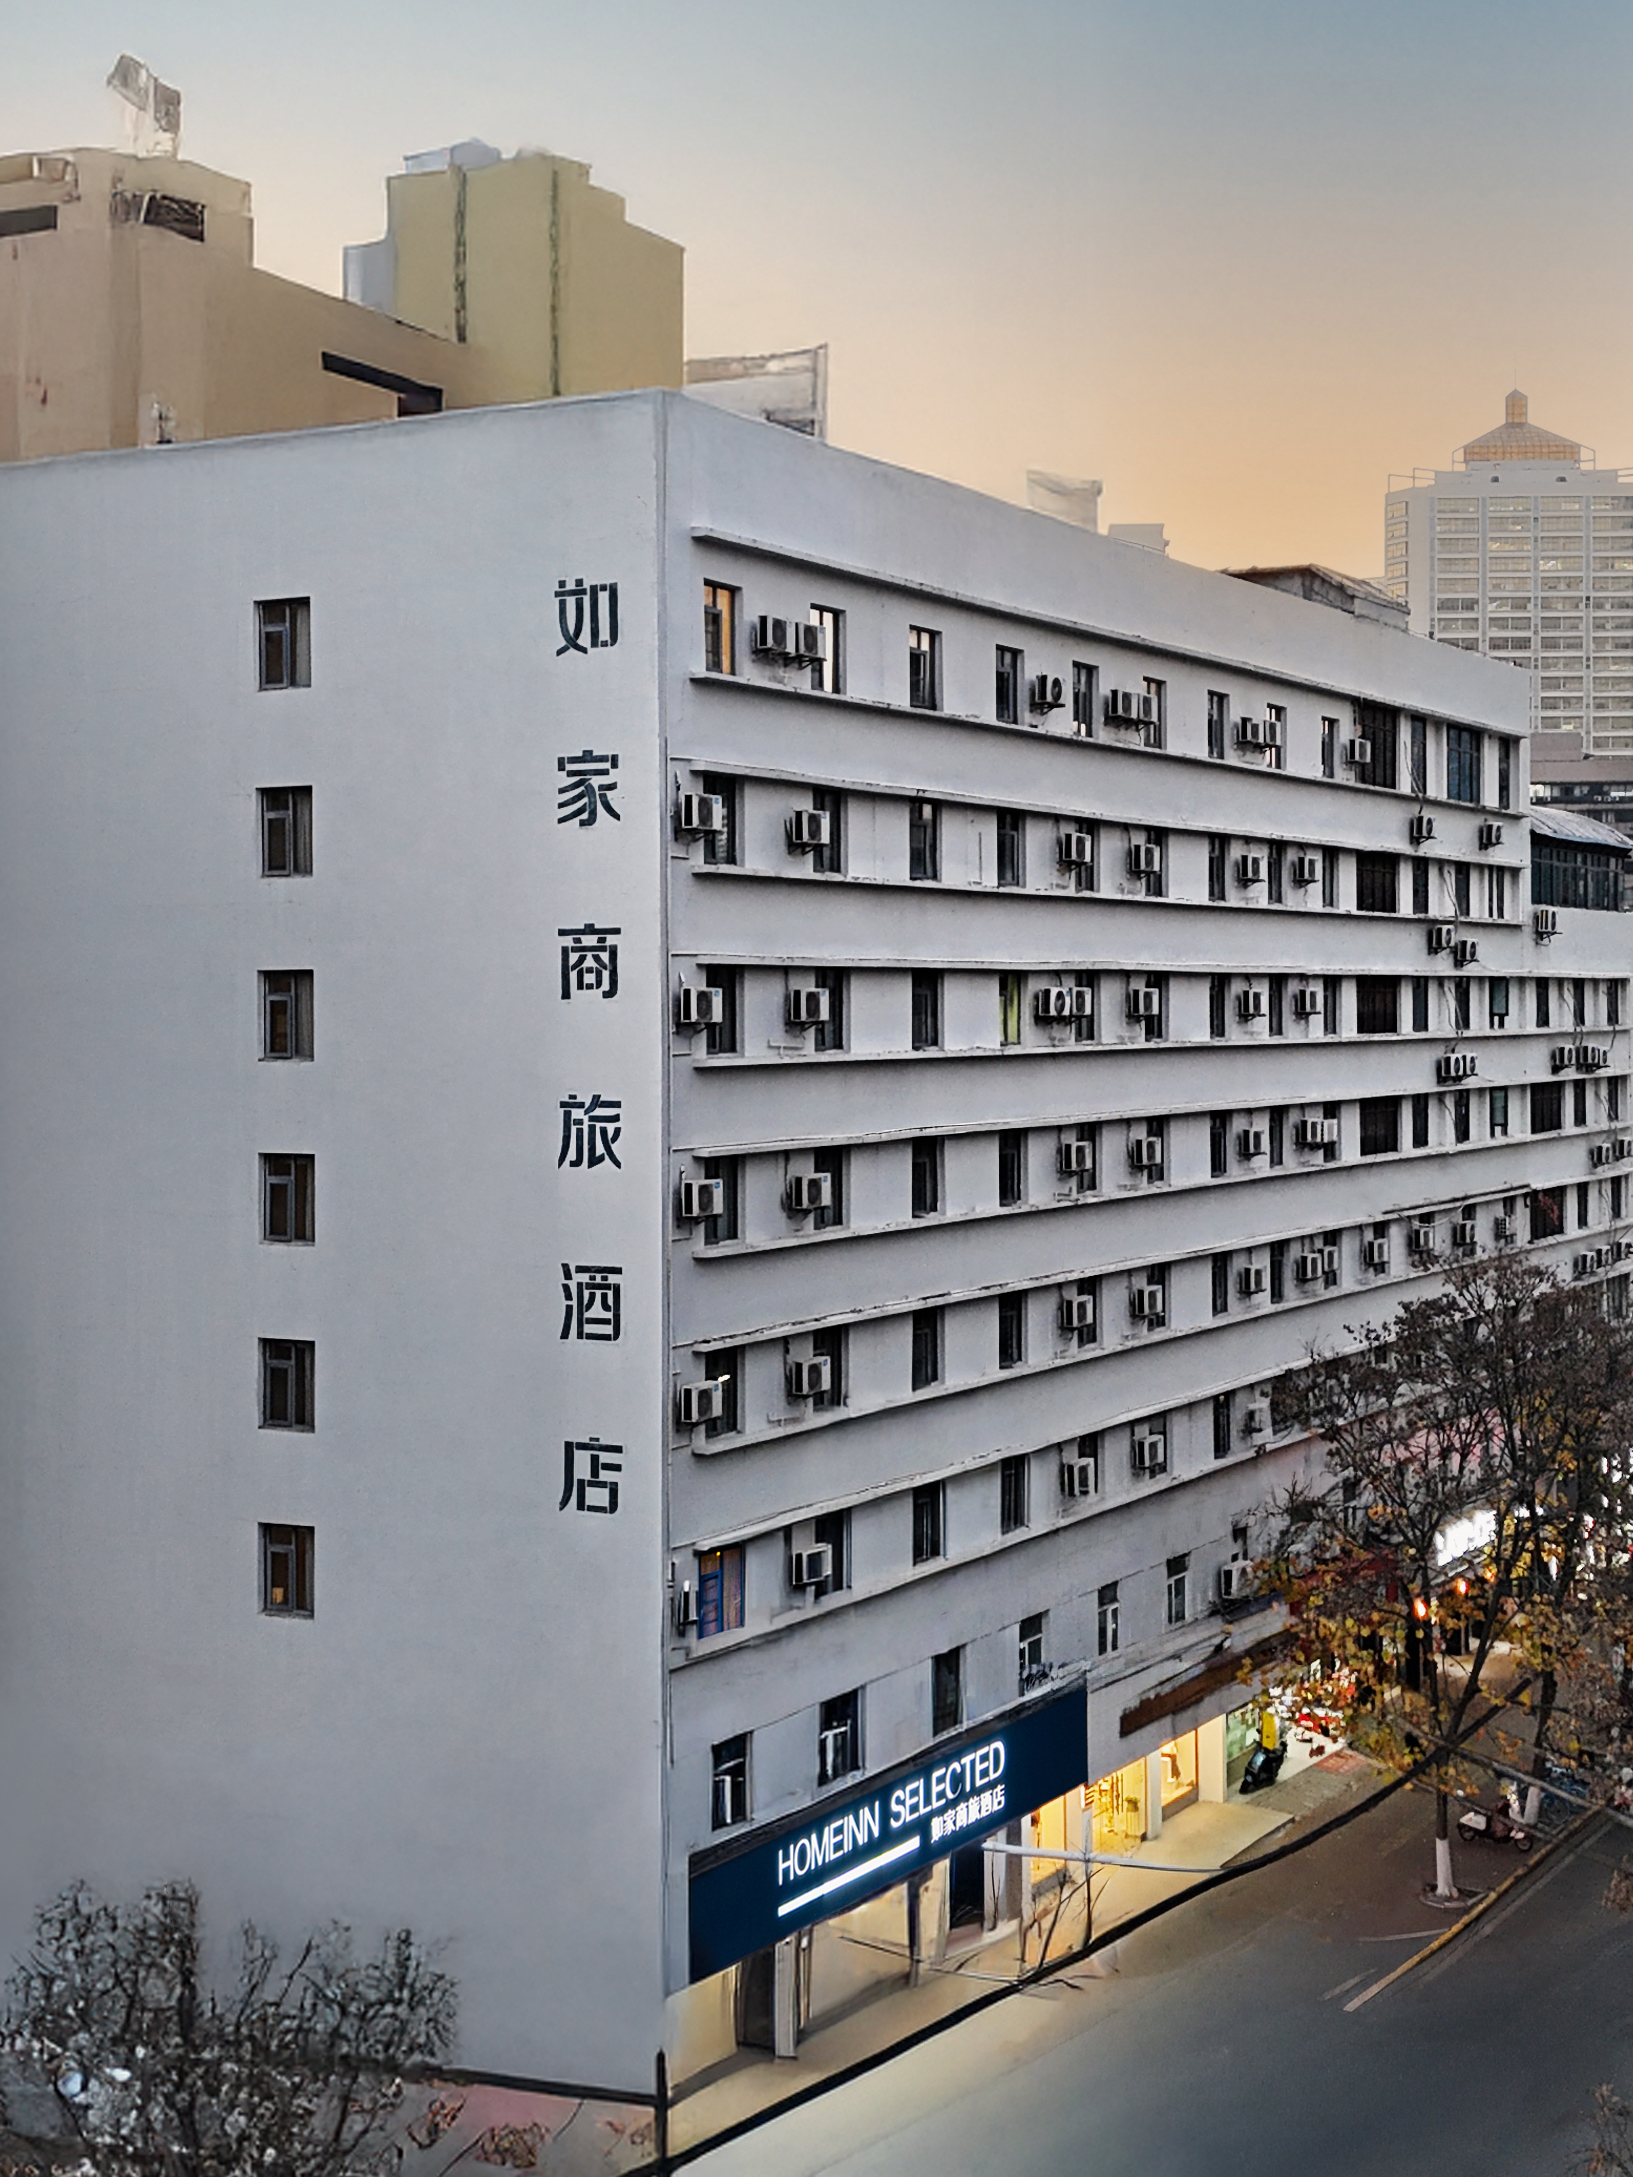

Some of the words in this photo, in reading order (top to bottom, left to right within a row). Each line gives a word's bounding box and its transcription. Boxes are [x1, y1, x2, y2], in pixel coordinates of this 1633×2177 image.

[554, 578, 624, 1515] 如家商旅酒店
[777, 1801, 880, 1886] HOMEINN
[889, 1740, 1006, 1829] SELECTED
[930, 1784, 1006, 1844] 如家商旅酒店
